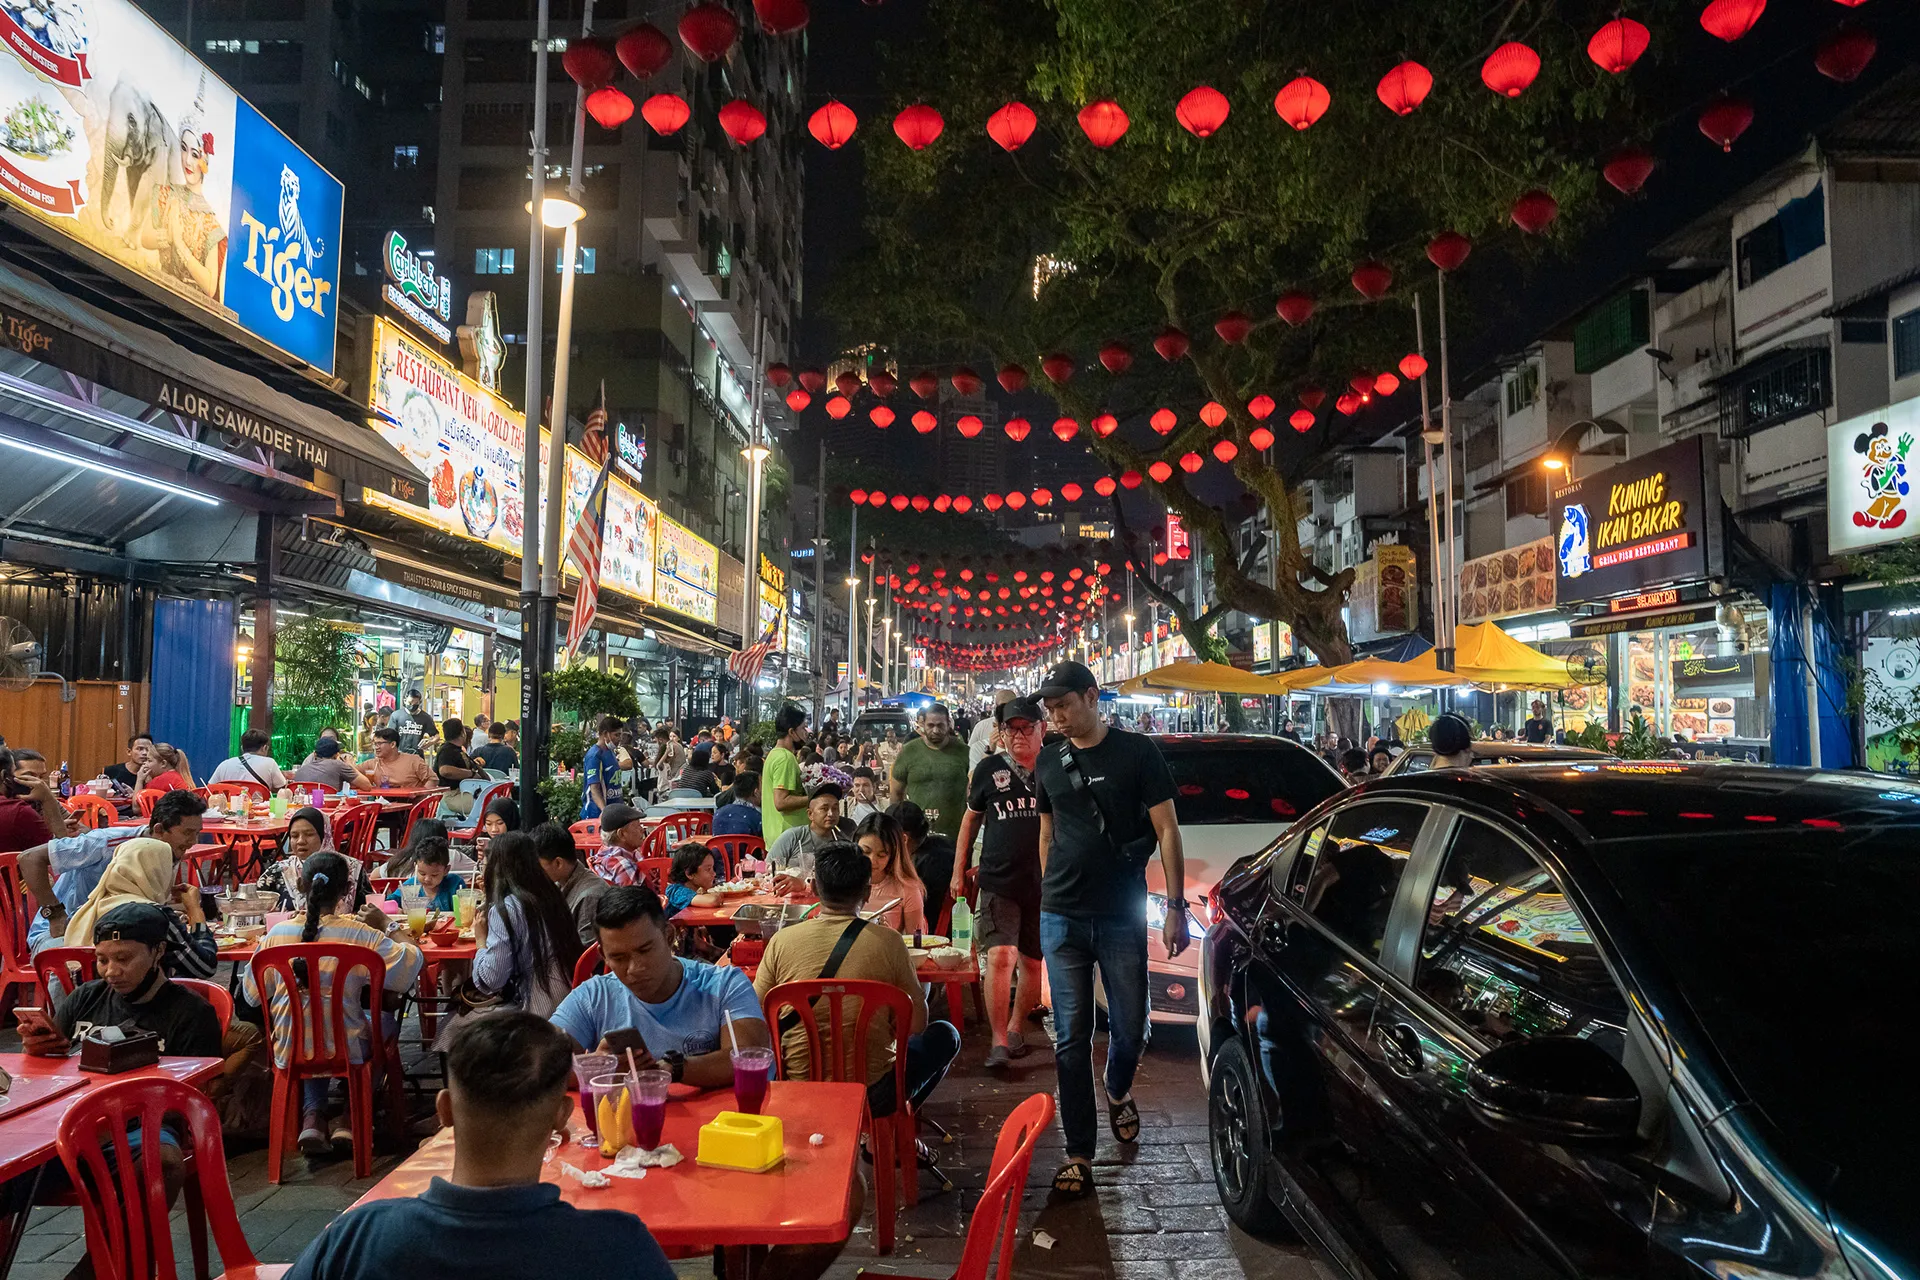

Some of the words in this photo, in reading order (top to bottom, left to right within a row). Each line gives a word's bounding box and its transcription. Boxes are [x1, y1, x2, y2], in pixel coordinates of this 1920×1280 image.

[0, 166, 20, 188] EMON
[240, 209, 332, 322] Tiger
[389, 231, 440, 310] Carlsberg
[7, 316, 53, 353] Tiger
[398, 338, 460, 386] RESTORAN
[395, 349, 460, 411] RESTAURANT
[461, 391, 480, 423] NEW
[158, 383, 210, 421] ALOR
[212, 405, 293, 454] SAWADEE
[296, 438, 329, 469] THAI
[397, 479, 416, 500] Tiger
[1555, 483, 1583, 500] RESTORAN
[1608, 472, 1664, 517] KUNING
[1596, 513, 1630, 550] IKAN
[1631, 500, 1681, 540] BAKAR
[1598, 553, 1618, 566] GRILL
[1618, 549, 1633, 561] FISH
[1634, 538, 1679, 558] RESTAURANT
[403, 571, 416, 582] THAI
[415, 574, 430, 587] STYLE
[430, 578, 442, 590] SOUR
[446, 582, 459, 595] SPICY
[458, 586, 473, 597] STEAM
[472, 590, 482, 600] FISH
[1645, 616, 1664, 628] KUNING
[1664, 614, 1678, 626] IKAN
[1678, 611, 1696, 623] BAKAR
[993, 797, 1037, 820] LOND
[1008, 809, 1041, 819] ORIGIN
